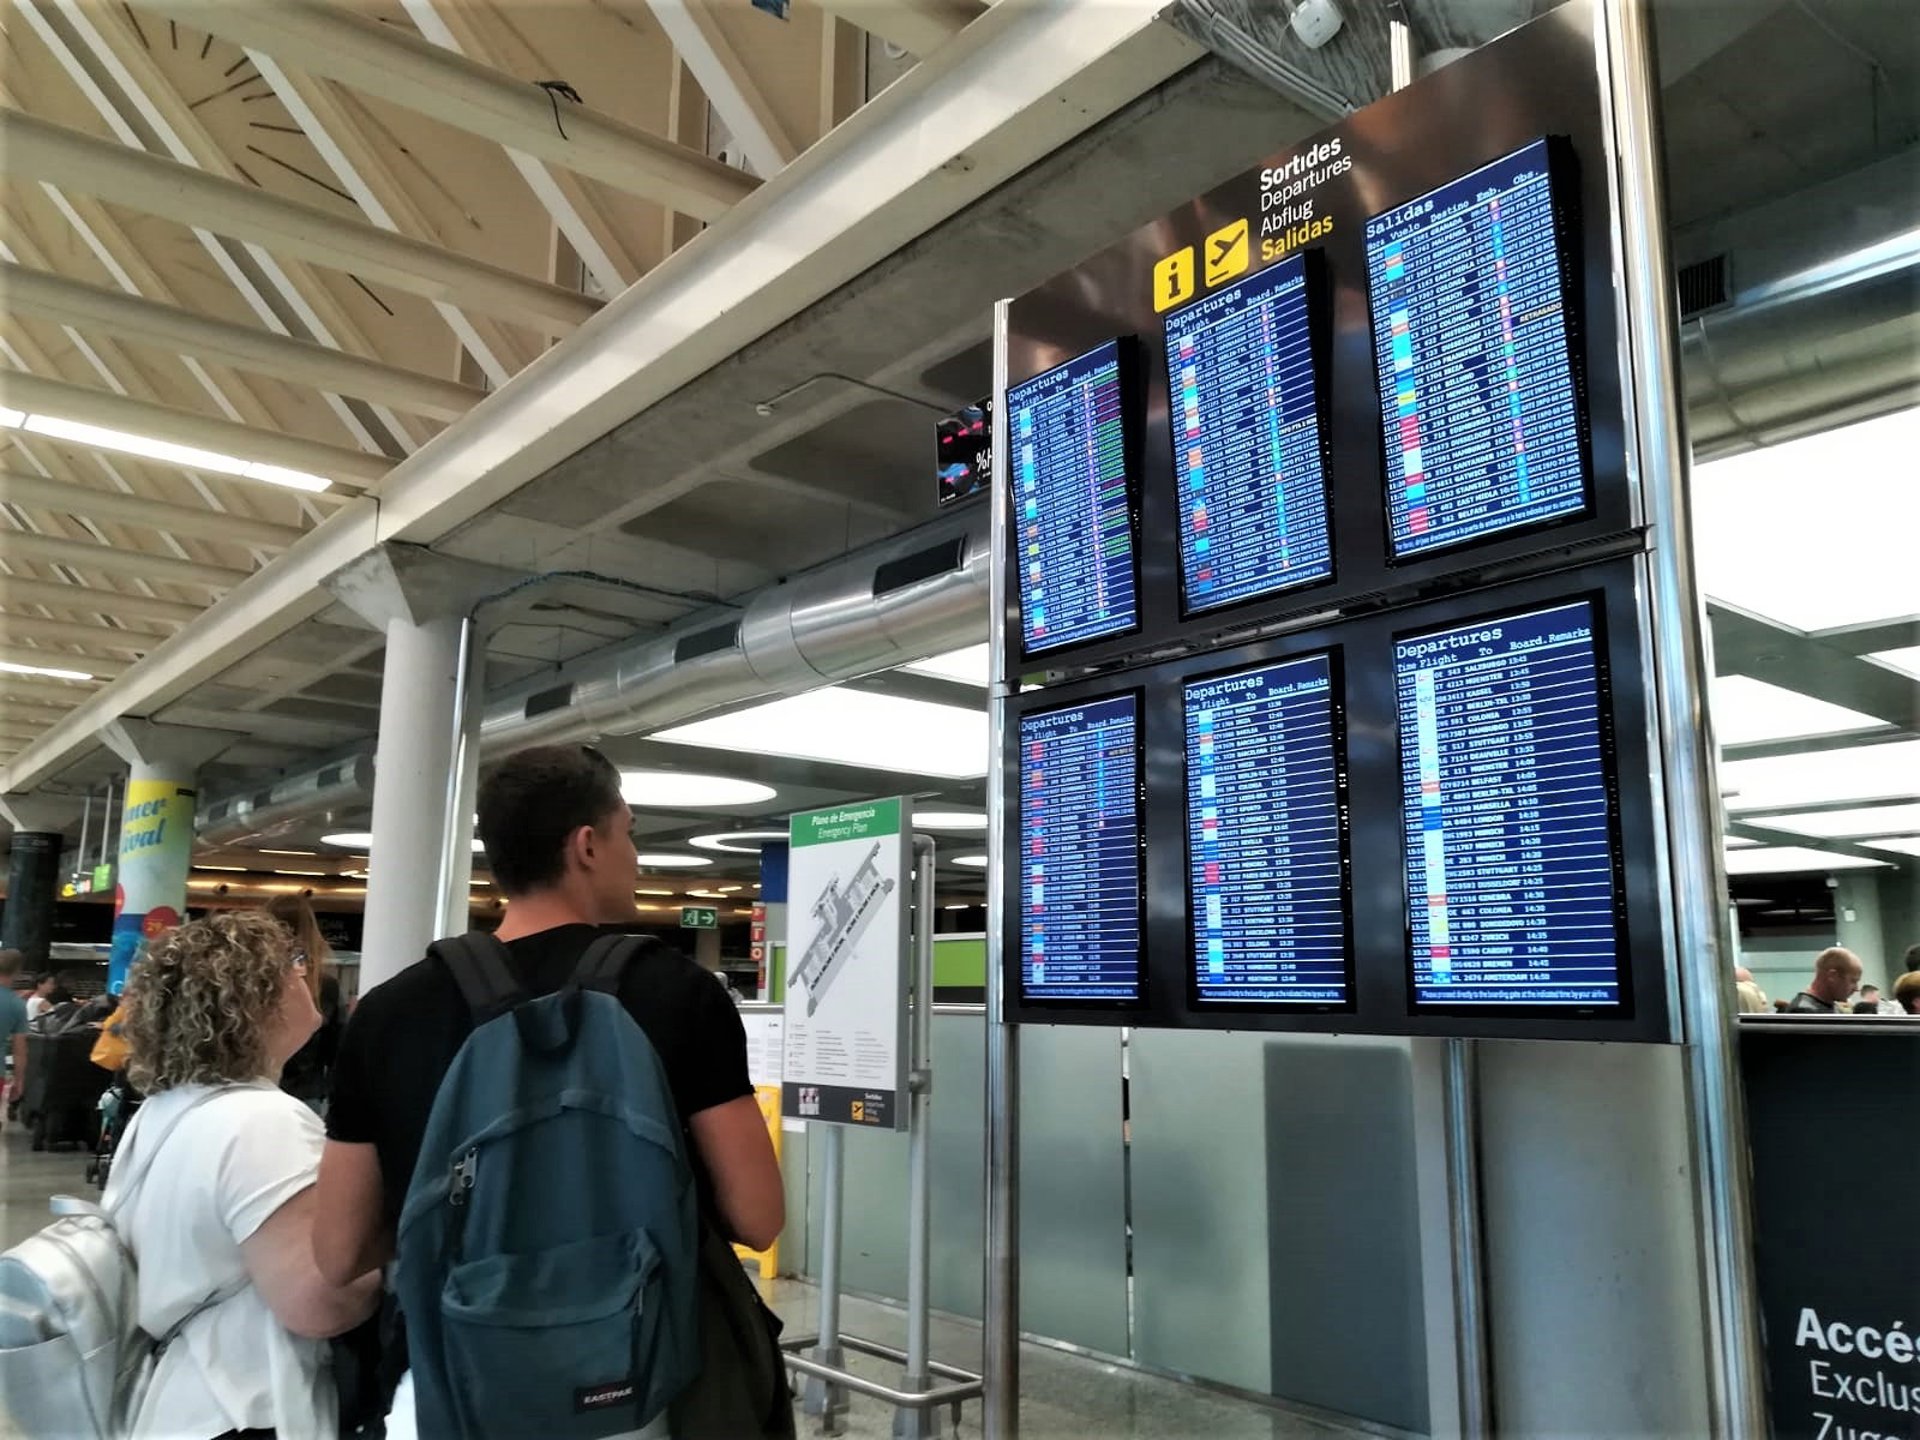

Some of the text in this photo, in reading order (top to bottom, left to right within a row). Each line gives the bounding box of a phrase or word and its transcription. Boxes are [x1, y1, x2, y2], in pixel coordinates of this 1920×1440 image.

[1260, 138, 1341, 190] Sortides
[1261, 155, 1352, 211] Departures
[1261, 199, 1314, 237] Abflug
[1366, 199, 1434, 239] Salidas
[1389, 222, 1421, 240] Vuelo
[1430, 200, 1470, 223] Destino
[1476, 187, 1501, 203] Emb.
[1512, 171, 1539, 185] Obs.
[1261, 216, 1333, 261] Salidas
[1165, 289, 1242, 332] Departures
[1224, 306, 1236, 316] To
[1008, 369, 1069, 404] Departures
[1396, 628, 1503, 659] Departures
[1397, 627, 1591, 673] Time Flight To Board. Remarks
[1185, 676, 1264, 702] Departures
[1201, 697, 1231, 712] Flight
[1245, 692, 1257, 701] To
[1268, 683, 1297, 697] Board.
[1021, 711, 1084, 733] Departures
[1795, 1306, 1920, 1364] Accé
[584, 1386, 632, 1404] EASTPAK
